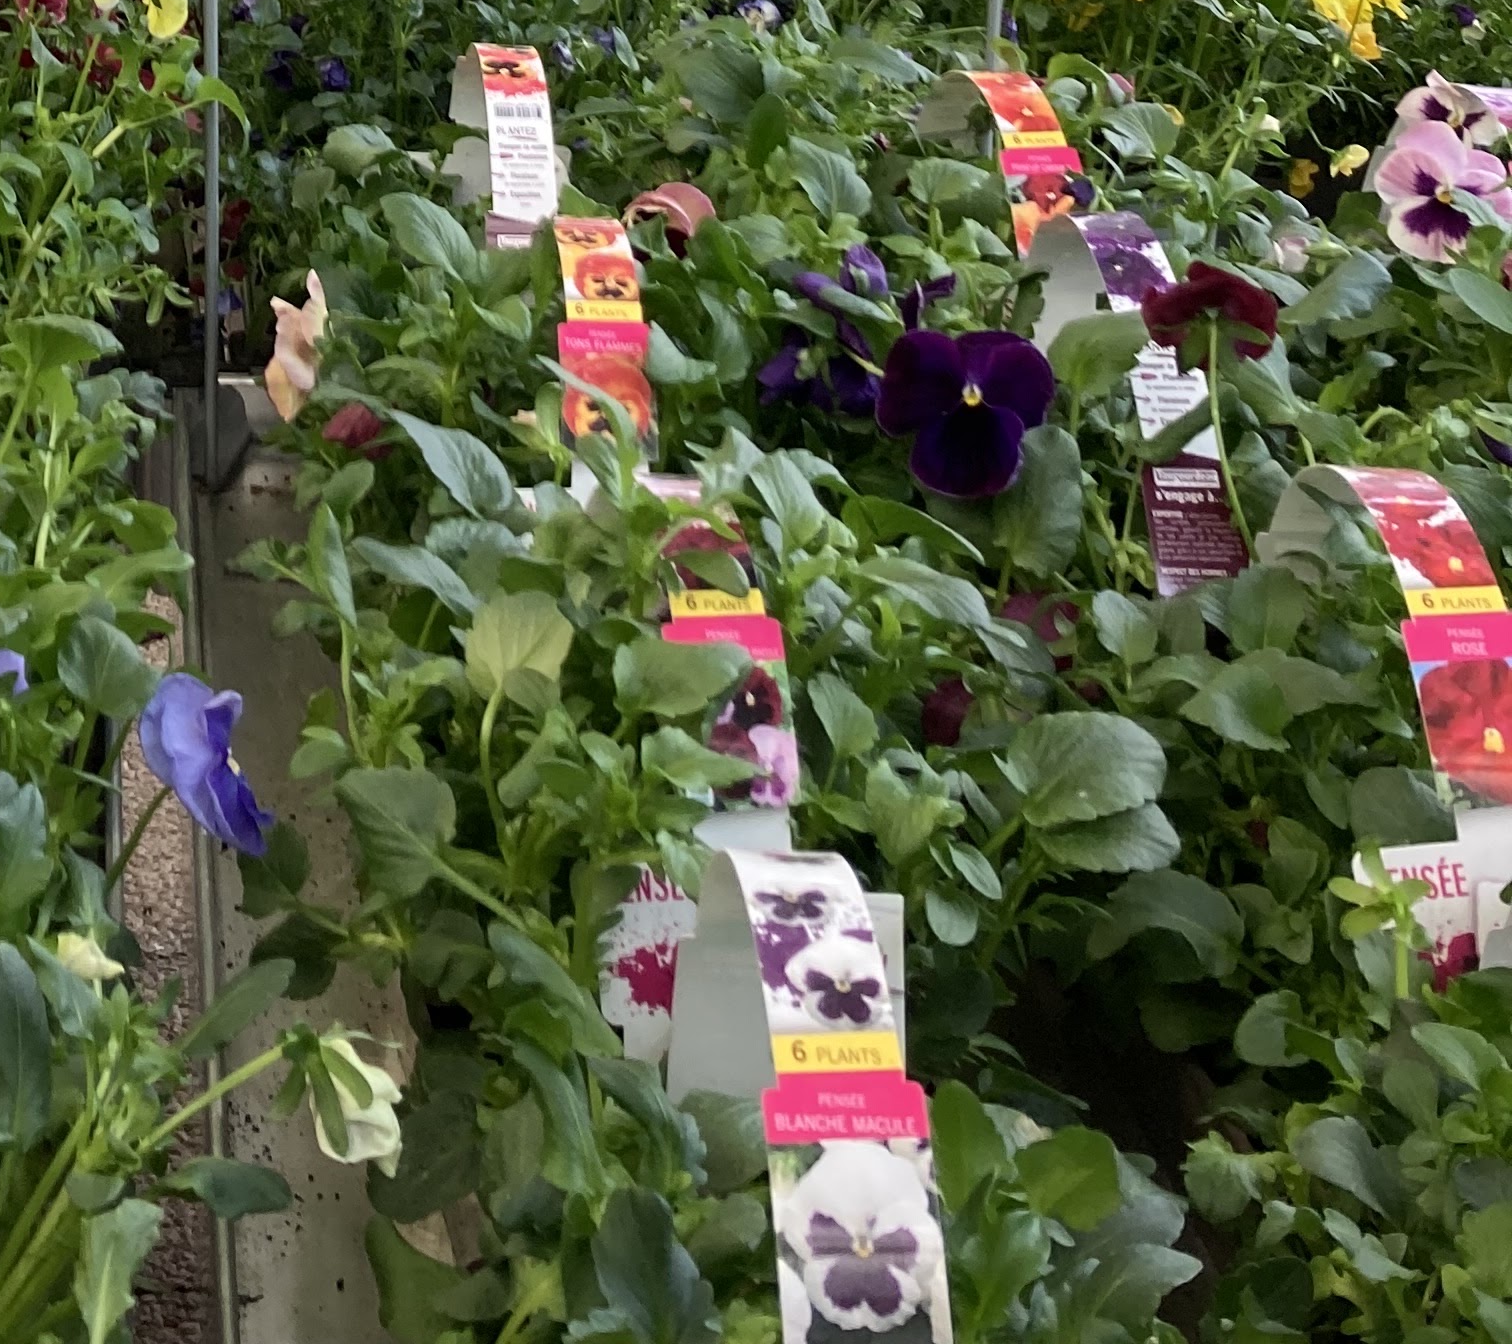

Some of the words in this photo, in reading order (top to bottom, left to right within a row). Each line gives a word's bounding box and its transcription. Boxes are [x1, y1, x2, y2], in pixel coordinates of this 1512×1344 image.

[686, 594, 697, 610] 6
[704, 599, 752, 611] PLANTS
[1422, 592, 1435, 608] 6
[1441, 598, 1492, 609] PLANTS
[1451, 642, 1488, 655] ROSE
[1388, 857, 1470, 900] SÉE
[791, 1040, 807, 1062] 6
[816, 1046, 881, 1065] PLANTS
[774, 1113, 848, 1133] BLANCHE
